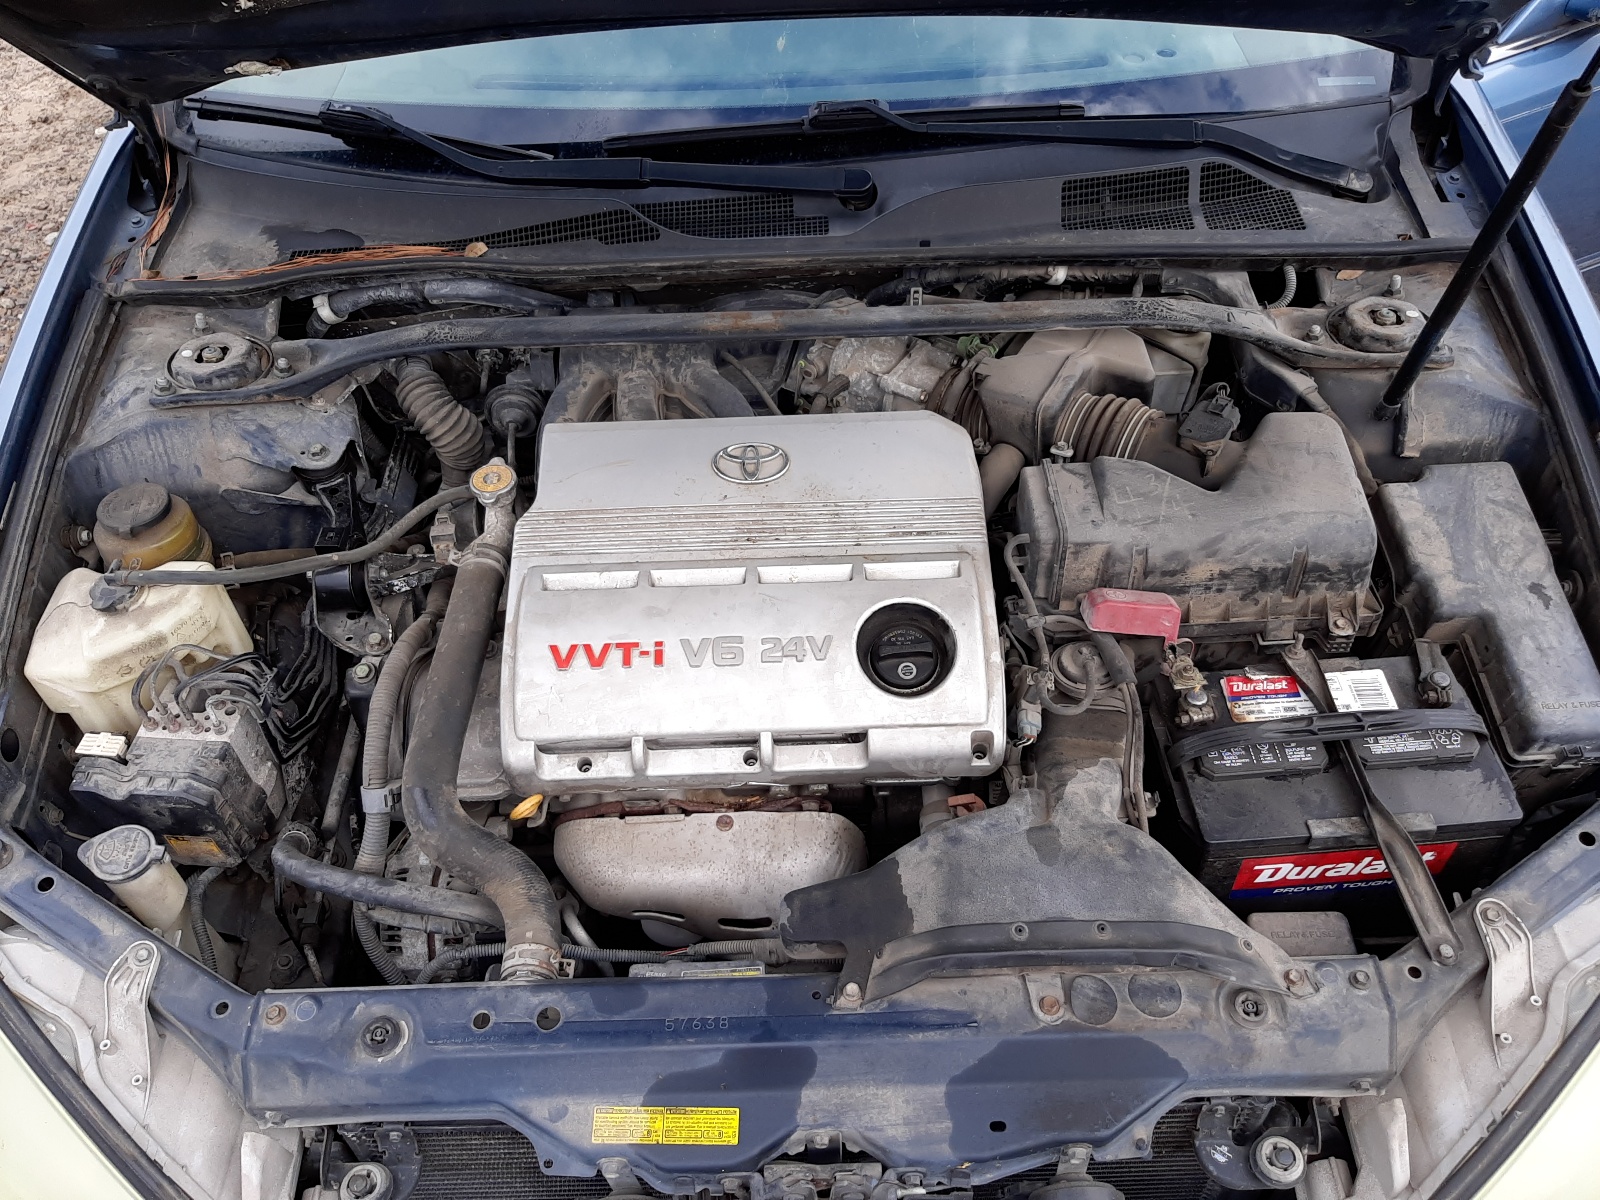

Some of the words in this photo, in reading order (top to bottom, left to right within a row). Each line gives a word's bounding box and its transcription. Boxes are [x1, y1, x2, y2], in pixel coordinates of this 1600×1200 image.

[549, 641, 666, 671] VVT-i
[680, 635, 745, 668] V6
[761, 635, 833, 664] 24V
[1229, 679, 1289, 692] Duralast
[1541, 701, 1568, 709] RELAY
[1253, 851, 1438, 883] Durala
[1273, 883, 1338, 894] PROVEN
[1342, 879, 1395, 889] TOUGH
[1270, 930, 1300, 939] RELAY
[664, 1015, 729, 1031] 57638
